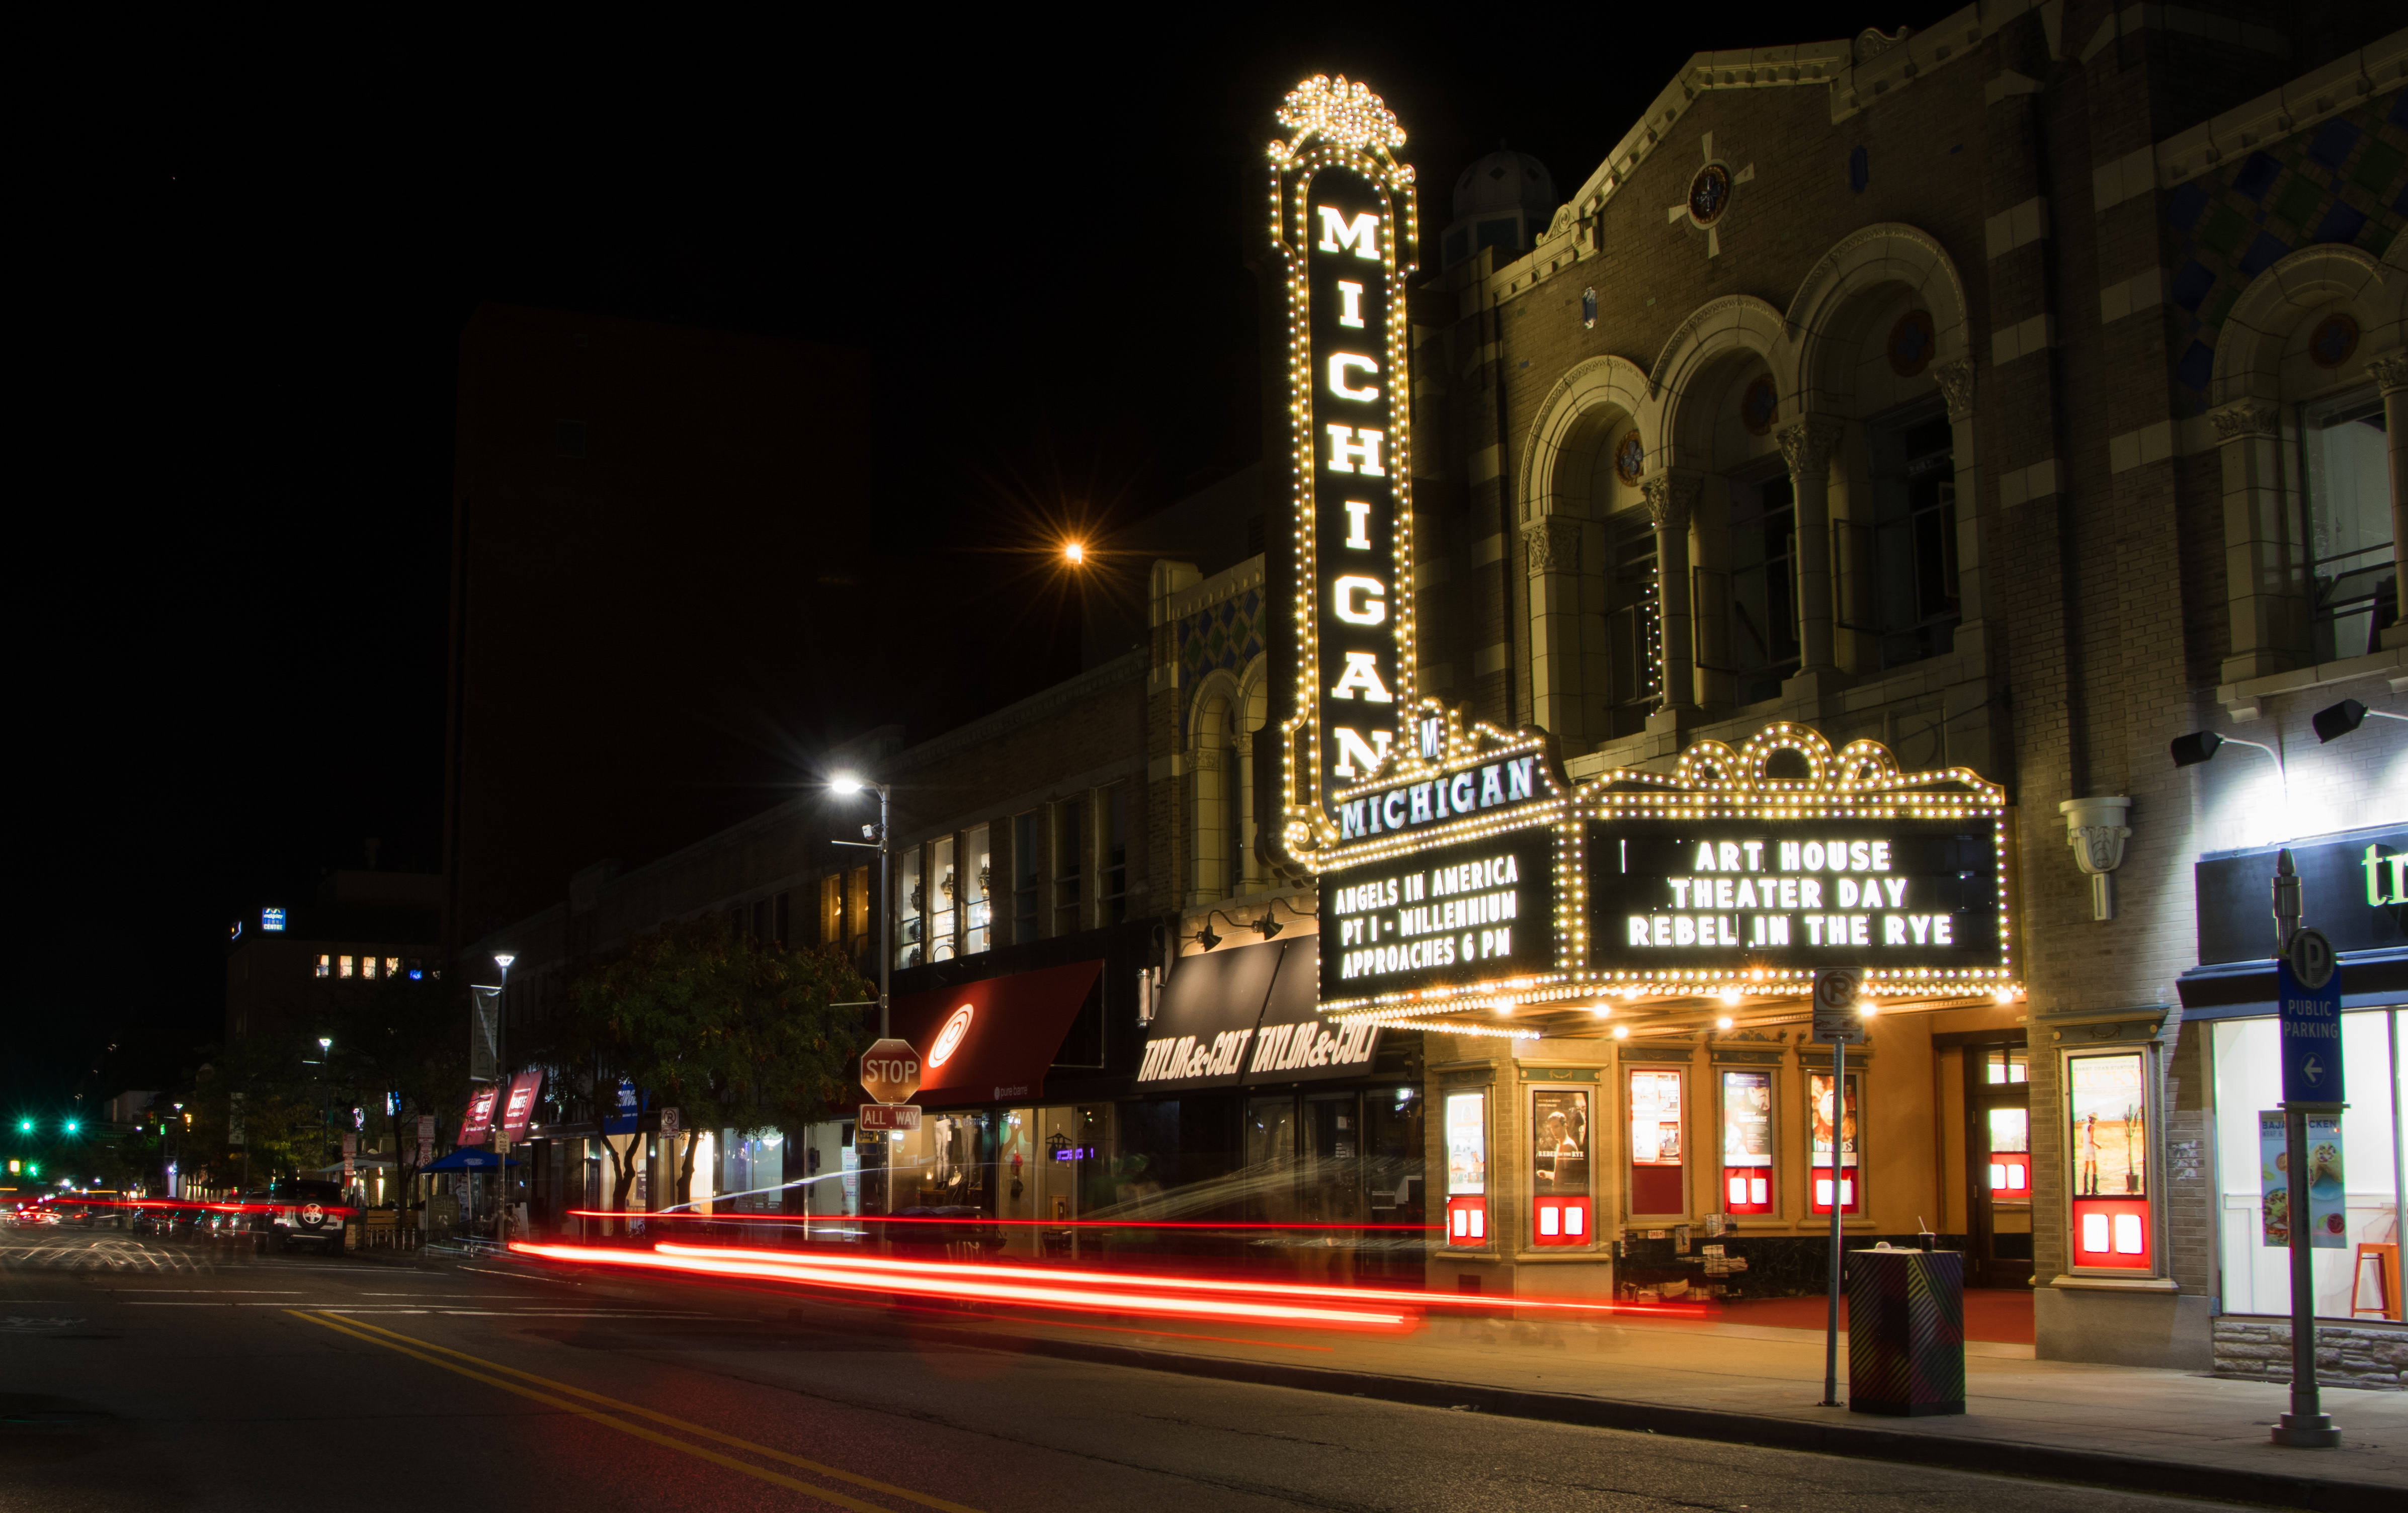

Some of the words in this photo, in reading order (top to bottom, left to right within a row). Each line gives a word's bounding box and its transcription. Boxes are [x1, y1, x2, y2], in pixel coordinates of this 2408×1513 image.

[1317, 205, 1393, 777] MICHIGAN
[1421, 717, 1439, 758] M
[1341, 755, 1534, 840] MICHIGAN
[1695, 842, 1764, 872] ART
[1781, 842, 1891, 871] HOUSE
[1336, 878, 1398, 915] ANGELS
[1405, 874, 1425, 902] IN
[1433, 855, 1518, 897] AMERICA
[1671, 879, 1822, 908] THEATER
[1839, 879, 1908, 908] DAY
[1342, 918, 1364, 946] PT
[1384, 922, 1393, 931] -
[1400, 891, 1517, 937] MILLENNIUM
[1629, 915, 1737, 946] REBEL
[1755, 916, 1790, 945] IN
[1805, 916, 1870, 945] THE
[1886, 916, 1953, 945] RYE
[1342, 937, 1455, 979] APPROACHES
[1463, 934, 1474, 961] 6
[1482, 928, 1511, 959] PM
[2288, 999, 2332, 1017] PUBLIC
[2284, 1022, 2339, 1039] PARKING
[865, 1059, 918, 1083] STOP
[2073, 1070, 2141, 1087] LUCKY
[511, 1096, 527, 1110] TASTE
[1001, 1087, 1013, 1100] pure
[1013, 1084, 1028, 1096] barre
[864, 1110, 886, 1125] ALL
[895, 1108, 920, 1125] WAY
[2262, 1121, 2285, 1130] BAJA
